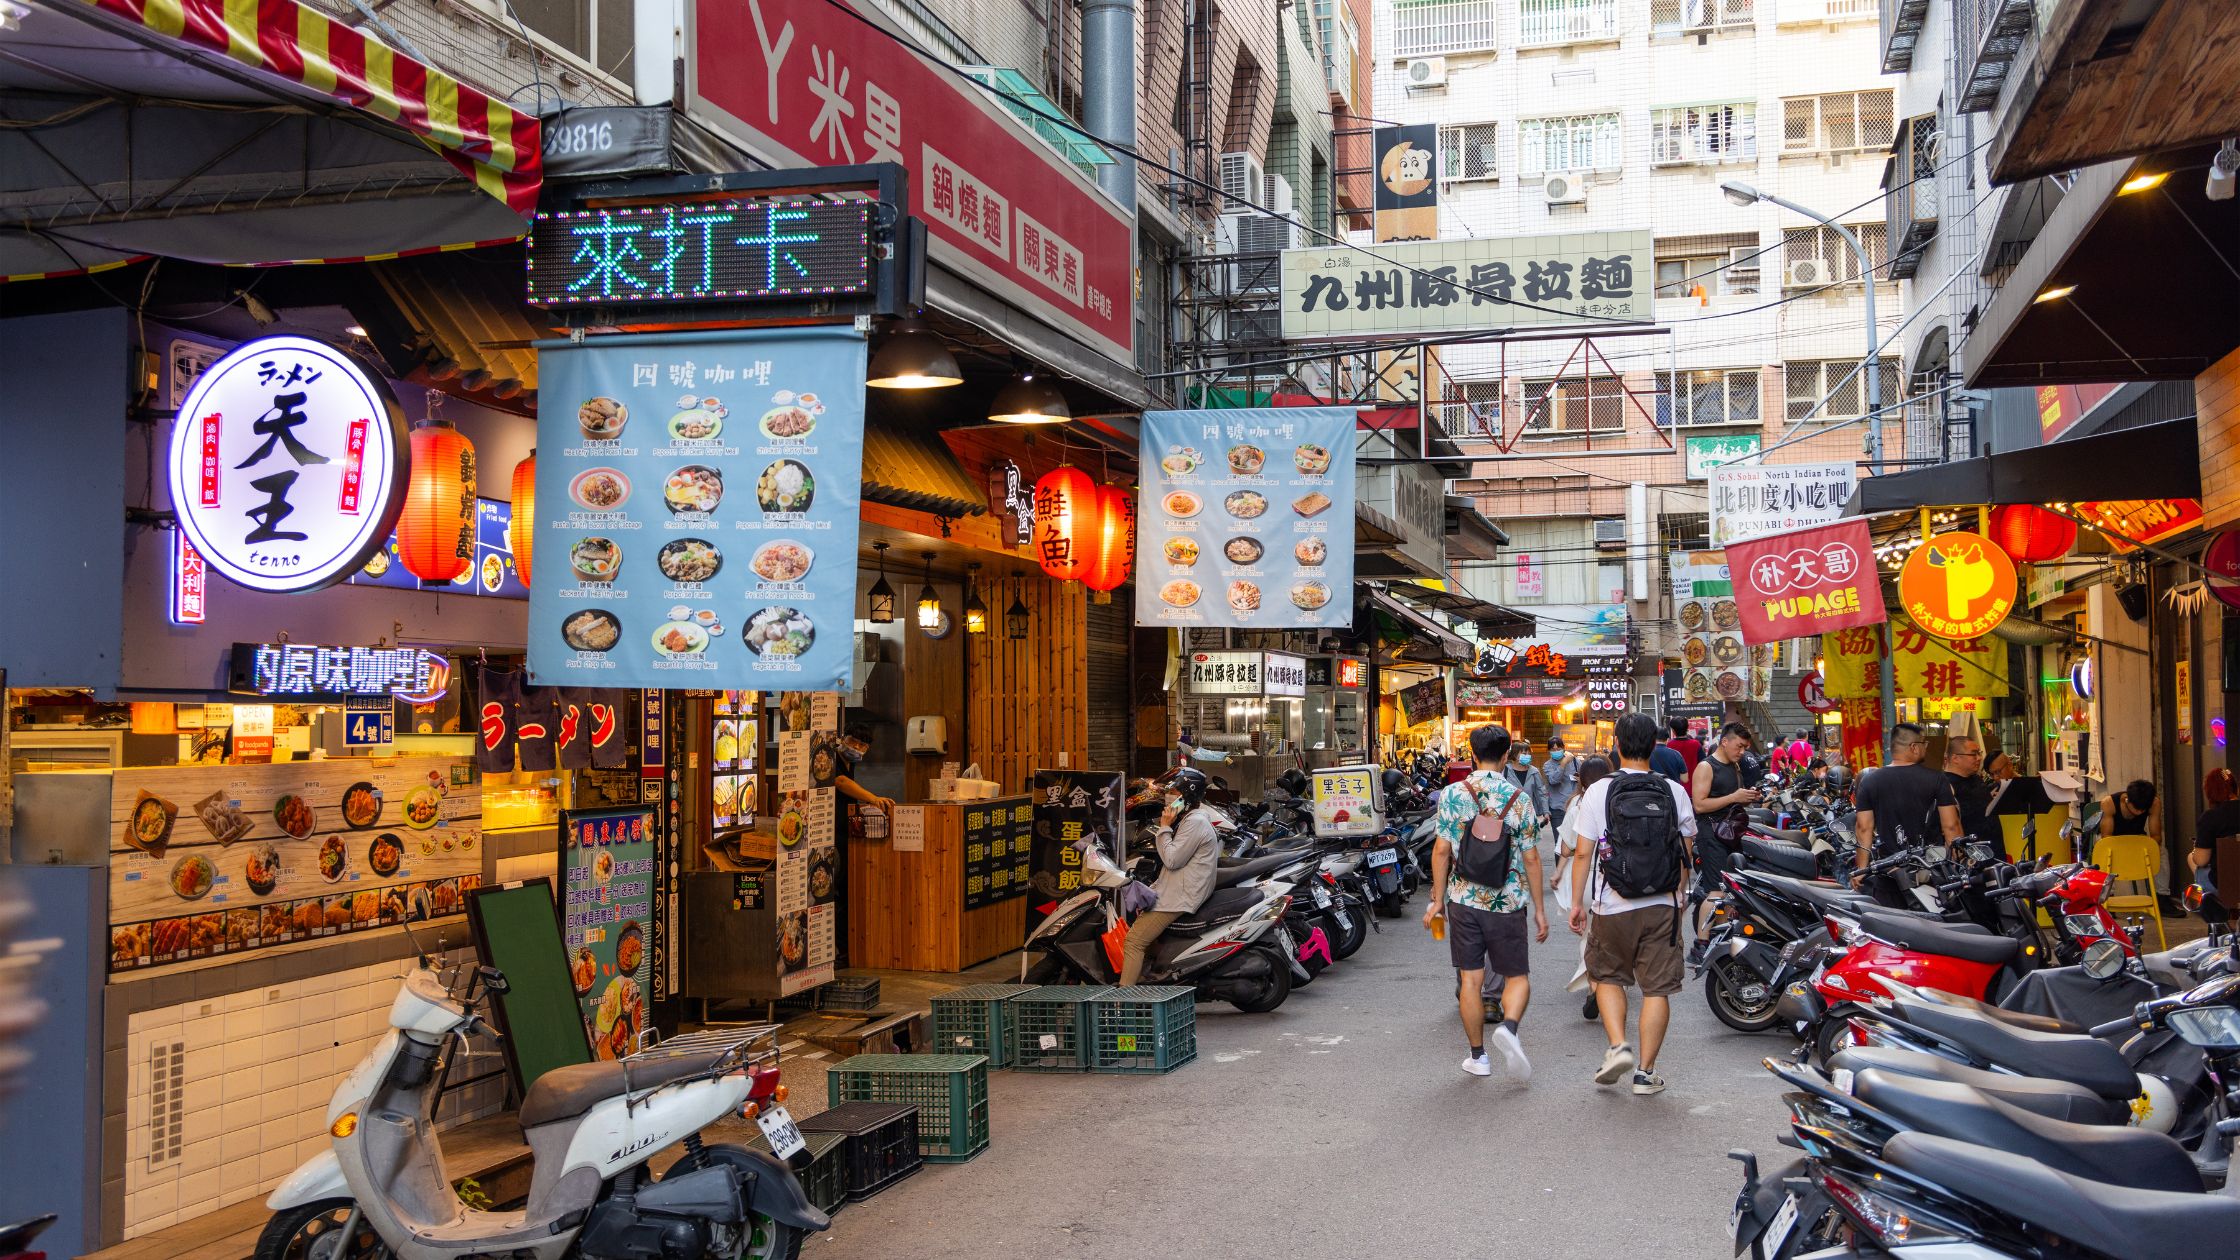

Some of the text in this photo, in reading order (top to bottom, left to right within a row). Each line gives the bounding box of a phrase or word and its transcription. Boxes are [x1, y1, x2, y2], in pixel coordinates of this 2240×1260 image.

[931, 163, 1003, 249] 鍋燒麵
[566, 203, 819, 296] 來打卡
[1022, 221, 1078, 297] 關東煮
[1300, 254, 1633, 313] 九州豚骨拉麵
[257, 361, 323, 388] ラーメン
[633, 360, 772, 388] 四號咖哩
[1203, 424, 1294, 440] 四號咖哩
[233, 391, 332, 546] 天王
[1765, 471, 1790, 480] North
[1795, 469, 1822, 478] Indian
[1825, 468, 1846, 476] Food
[1715, 481, 1850, 513] 北印度小吃吧
[1037, 485, 1079, 568] 鮭魚
[1738, 521, 1782, 531] PUNJABI
[249, 551, 301, 567] tenno
[1758, 548, 1851, 588] 朴大哥
[1765, 586, 1860, 622] PUDAGE
[1193, 663, 1257, 683] 九州豚骨拉麵
[1267, 665, 1303, 687] 九州豚骨拉麵
[1588, 681, 1628, 691] PUNCH
[242, 707, 266, 718] OPEN
[647, 688, 660, 748] 四號咖哩
[481, 702, 615, 752] ラーメン
[1046, 785, 1115, 809] 黑盒子
[1323, 778, 1365, 795] 黑盒子
[1059, 821, 1084, 890] 蛋包飯
[741, 881, 757, 889] Eats
